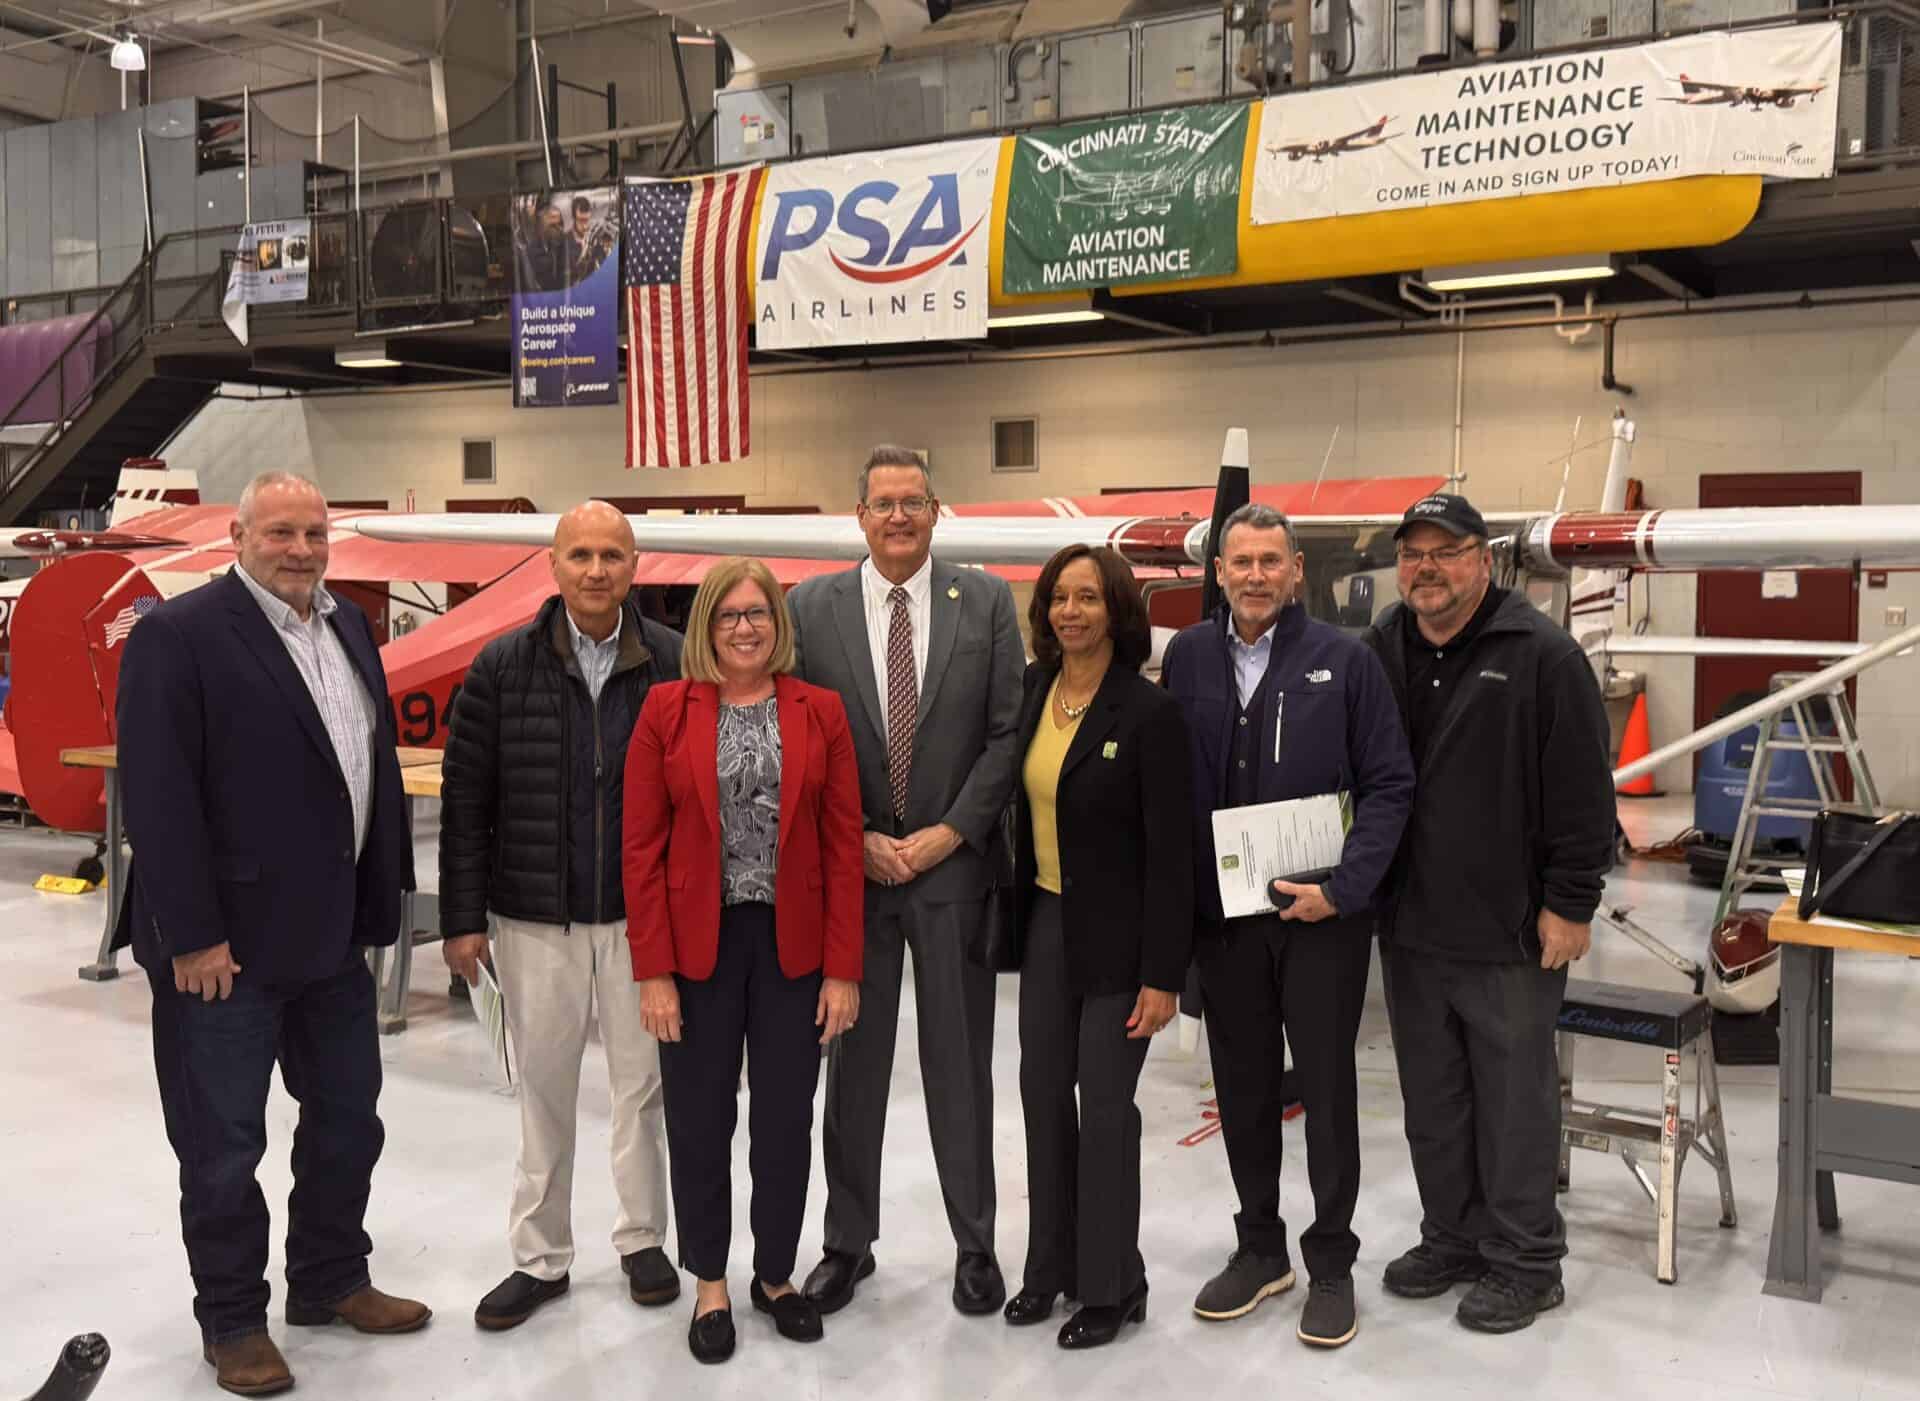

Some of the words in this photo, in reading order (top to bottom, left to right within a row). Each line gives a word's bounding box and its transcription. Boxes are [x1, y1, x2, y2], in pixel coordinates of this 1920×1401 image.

[1457, 57, 1604, 98] AVIATION
[1415, 86, 1645, 137] MAINTENANCE
[1037, 124, 1147, 173] CINCINNATI
[1153, 123, 1215, 153] STATE
[1421, 122, 1634, 169] TECHNOLOGY
[1376, 183, 1431, 202] COME
[1438, 180, 1456, 197] IN
[1463, 176, 1504, 193] AND
[1511, 168, 1559, 188] SIGN
[1567, 164, 1594, 182] UP
[1602, 154, 1679, 177] TODAY!
[761, 172, 967, 281] PSA
[1067, 224, 1165, 256] AVIATION
[1042, 248, 1191, 285] MAINTENANCE
[521, 306, 549, 320] Build
[550, 308, 558, 319] a
[559, 305, 595, 319] Unique
[761, 290, 967, 323] AIRLINES
[521, 322, 576, 335] Aerospace
[521, 338, 557, 351] Career
